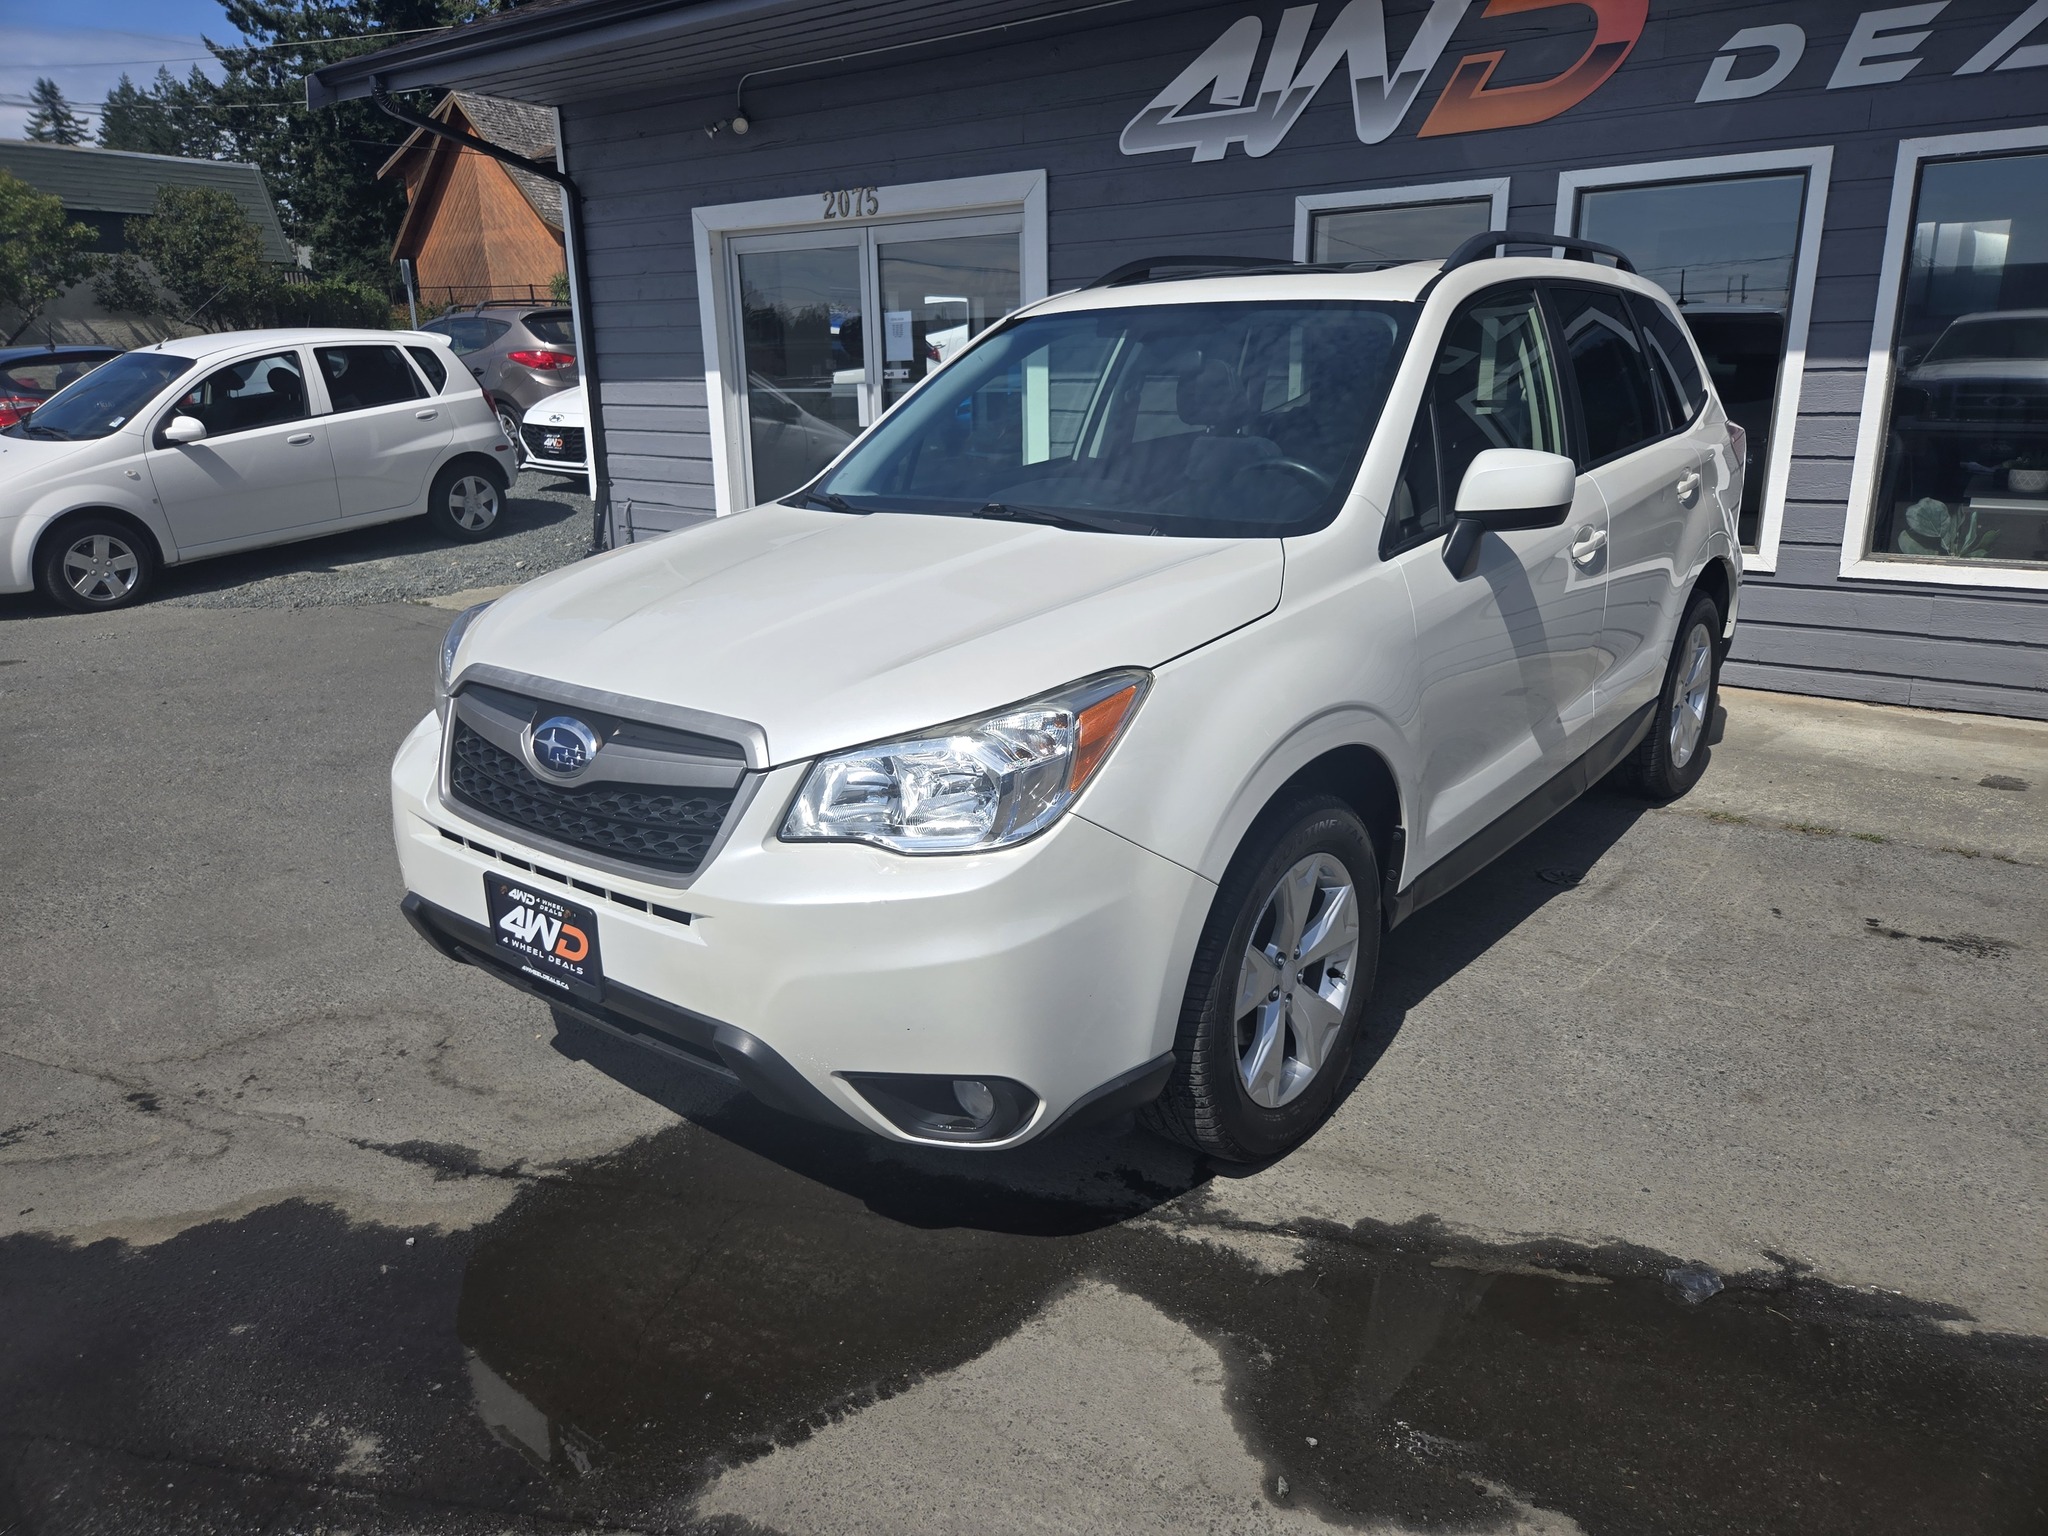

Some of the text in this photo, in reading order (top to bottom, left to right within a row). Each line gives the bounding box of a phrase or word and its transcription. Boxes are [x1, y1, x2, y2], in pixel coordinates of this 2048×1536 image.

[1119, 0, 1650, 163] 4WD
[823, 186, 879, 219] 2075
[508, 888, 535, 906] 4WD
[540, 904, 563, 917] DEALS
[542, 899, 564, 912] WHEEL
[500, 905, 589, 962] 4WD
[502, 936, 584, 975] 4 WHEEL DEALS
